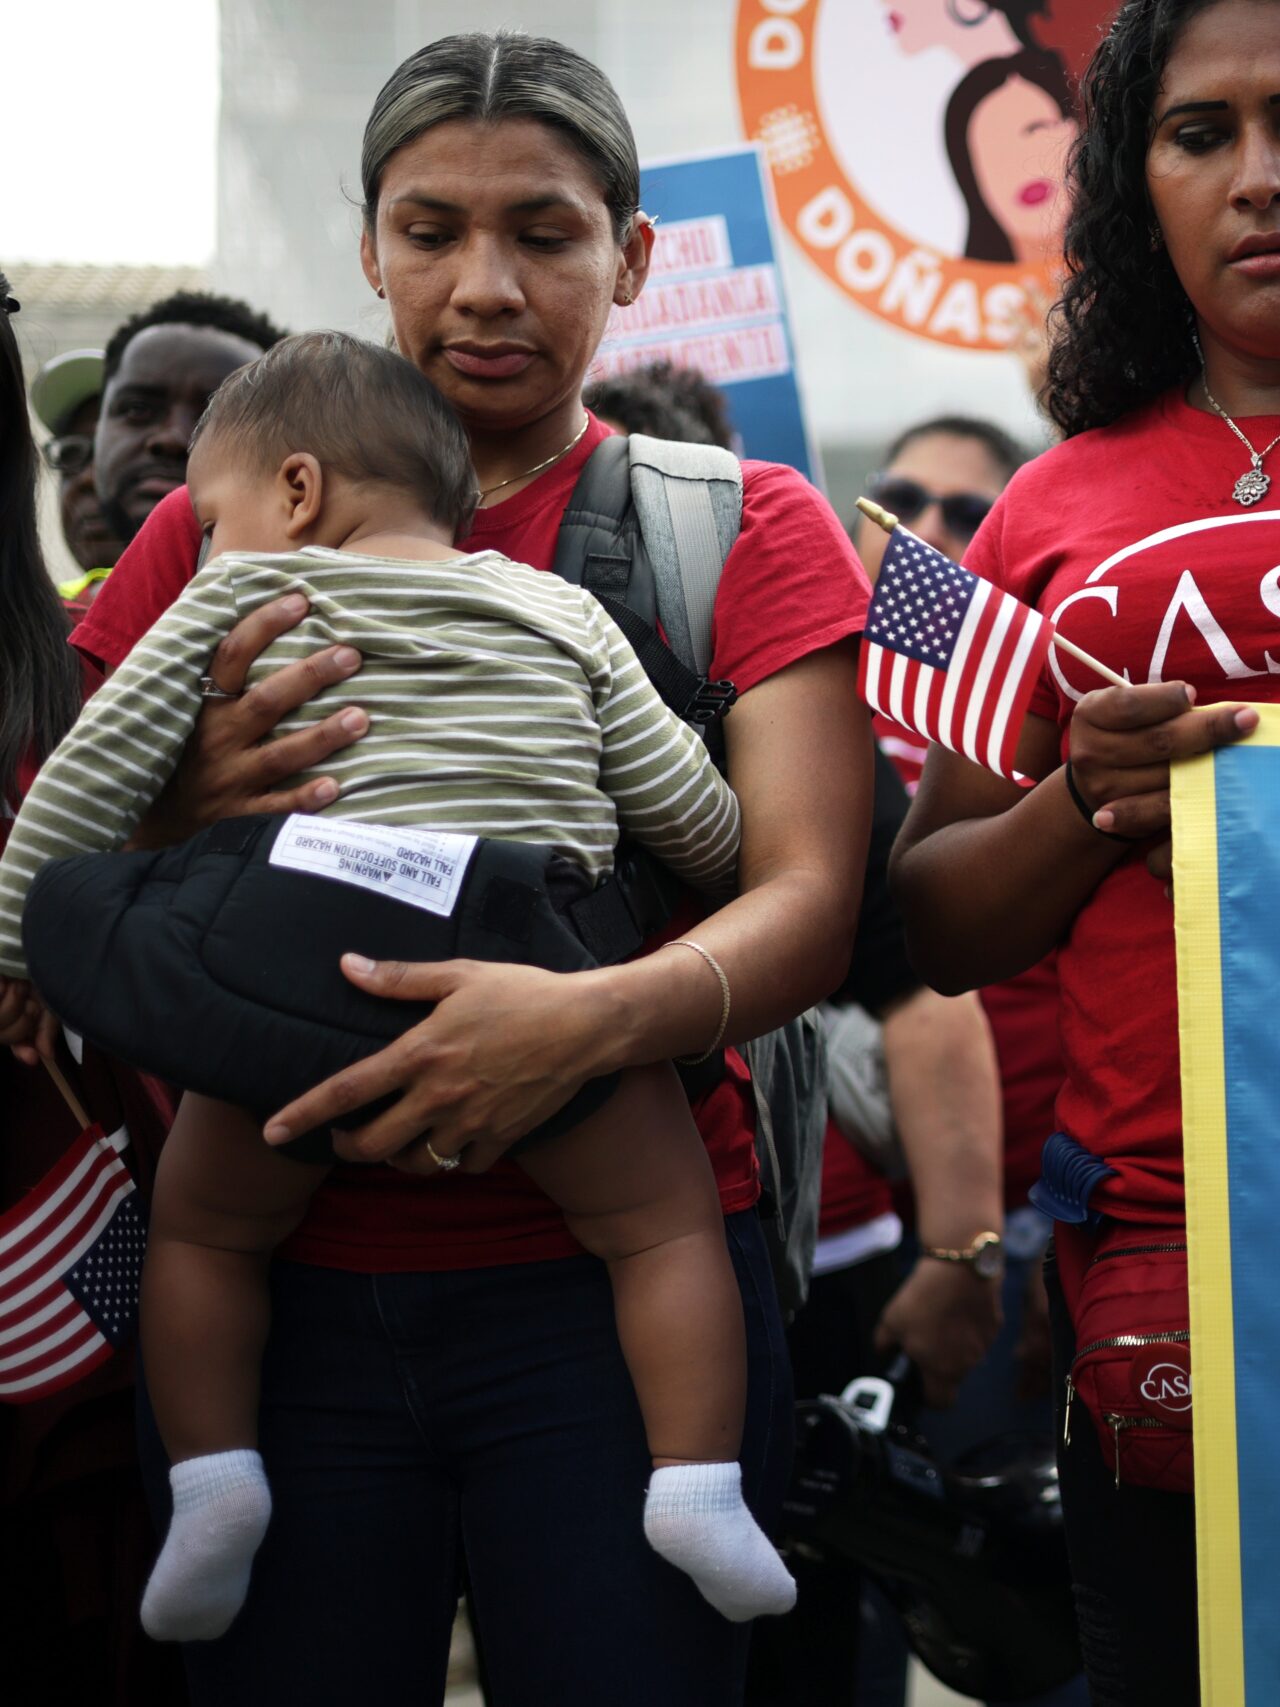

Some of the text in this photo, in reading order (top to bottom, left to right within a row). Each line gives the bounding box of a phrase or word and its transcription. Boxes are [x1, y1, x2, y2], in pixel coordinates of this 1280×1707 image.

[796, 184, 1028, 342] DOÑAS
[295, 836, 333, 851] HAZARD
[334, 844, 398, 873] SUFFOCATION
[338, 857, 385, 882] WARNING
[396, 846, 454, 877] FALL HAZARD
[399, 865, 419, 880] AND
[421, 873, 441, 888] FALL
